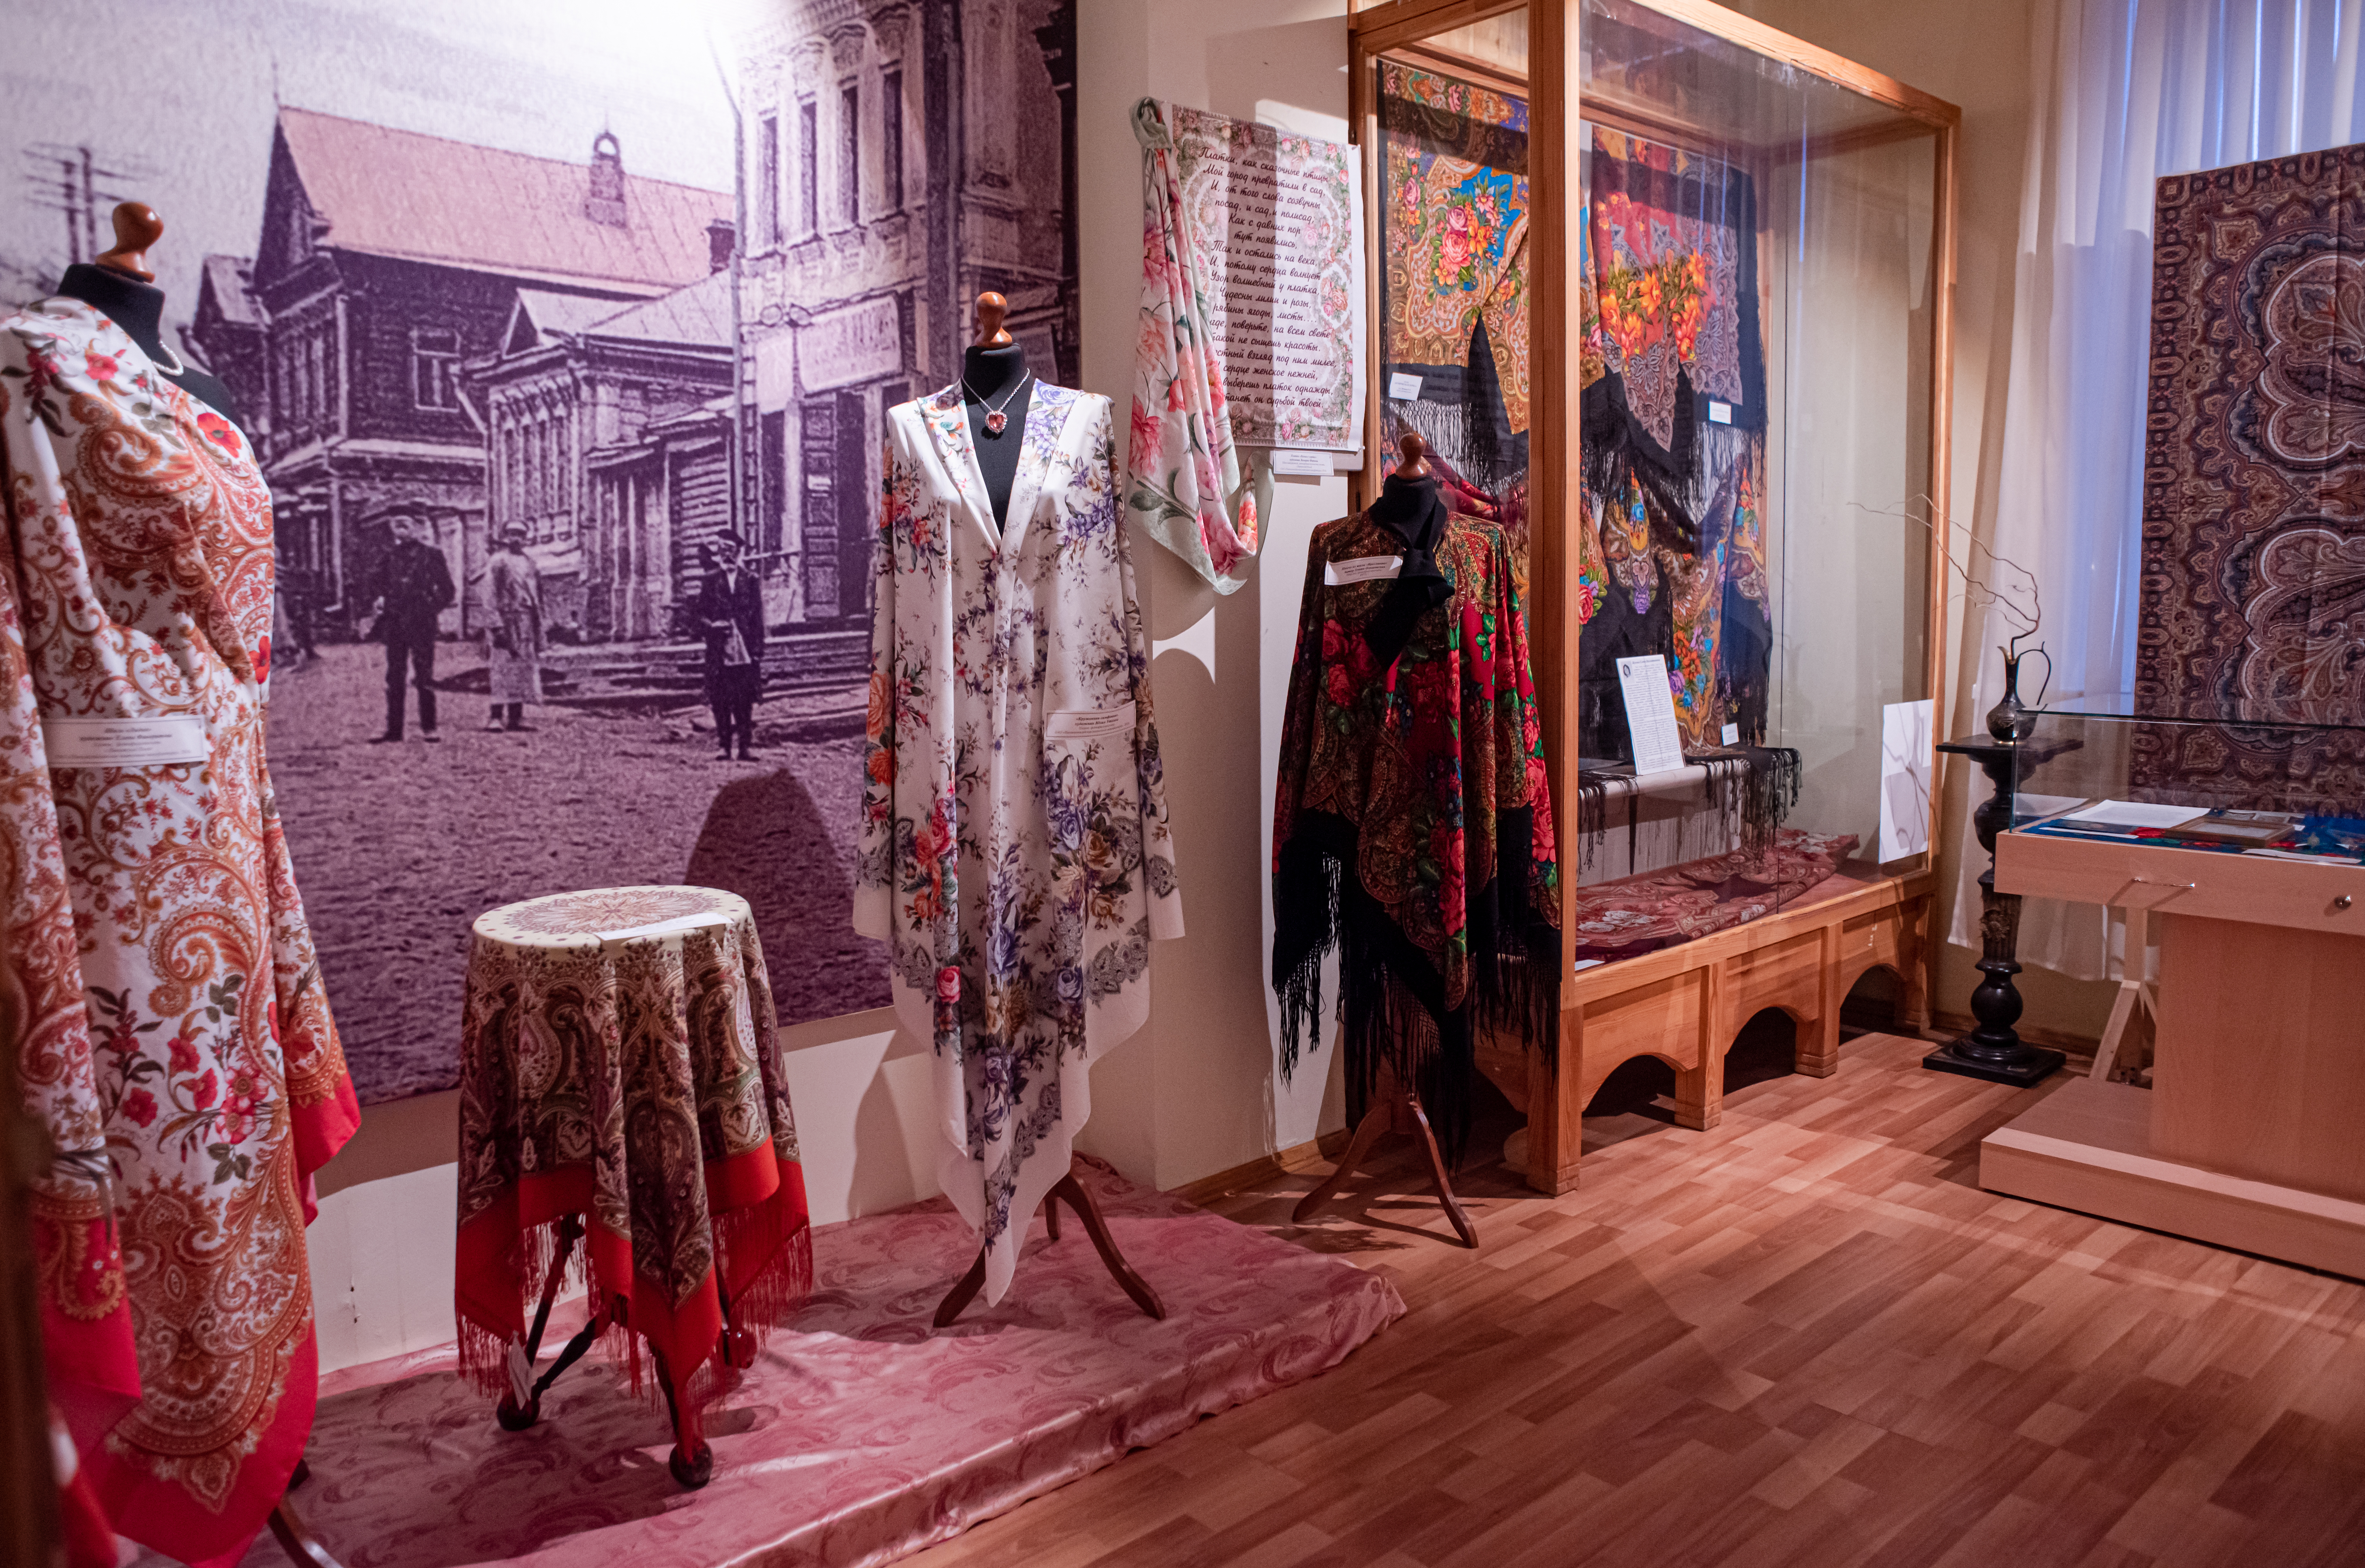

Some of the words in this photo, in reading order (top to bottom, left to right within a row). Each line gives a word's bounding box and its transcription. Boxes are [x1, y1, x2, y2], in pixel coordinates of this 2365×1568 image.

[1199, 147, 1237, 165] Платки,
[1243, 159, 1257, 167] как
[1261, 163, 1300, 176] сказочные
[1303, 171, 1328, 182] птицы
[1203, 163, 1223, 176] Мой
[1227, 169, 1248, 182] город
[1252, 174, 1298, 190] превратили
[1310, 187, 1326, 197] сад,
[1211, 180, 1220, 192] И,
[1225, 185, 1236, 193] от
[1240, 187, 1259, 197] того
[1262, 192, 1283, 202] слова
[1288, 197, 1320, 209] созвучны
[1215, 199, 1241, 211] посад,
[1228, 212, 1245, 225] Как
[1257, 221, 1284, 232] давних
[1288, 226, 1301, 237] пор
[1234, 231, 1253, 242] тут
[1256, 235, 1297, 249] появились,
[1211, 240, 1232, 253] Так
[1245, 249, 1281, 260] остались
[1298, 255, 1317, 266] века,
[1210, 255, 1219, 267] И,
[1225, 261, 1256, 275] потому
[1260, 266, 1286, 277] сердца
[1290, 268, 1321, 281] волнует
[1210, 270, 1229, 284] Узор
[1232, 275, 1276, 289] волшебный
[1279, 283, 1284, 292] у
[1287, 285, 1320, 295] платка,
[1220, 286, 1252, 301] Чудесны
[1255, 295, 1279, 304] лилии
[1290, 298, 1311, 309] розы,
[1213, 303, 1244, 314] рябины
[1247, 309, 1273, 319] ягоды,
[1232, 320, 1269, 332] поверьте,
[1288, 326, 1305, 336] всем
[1309, 329, 1331, 339] свете
[1251, 338, 1281, 347] сыщешь
[1284, 341, 1320, 352] красоты.
[1247, 350, 1273, 364] взгляд
[1276, 356, 1289, 366] под
[1311, 360, 1337, 368] милее,
[1223, 365, 1249, 376] сердце
[1253, 367, 1285, 377] женское
[1288, 370, 1318, 380] нежней,
[1223, 377, 1260, 391] выберешь
[1263, 382, 1292, 392] платок
[1295, 386, 1333, 396] однажды,
[1267, 396, 1295, 408] судьбой
[1298, 398, 1323, 408] твоей.
